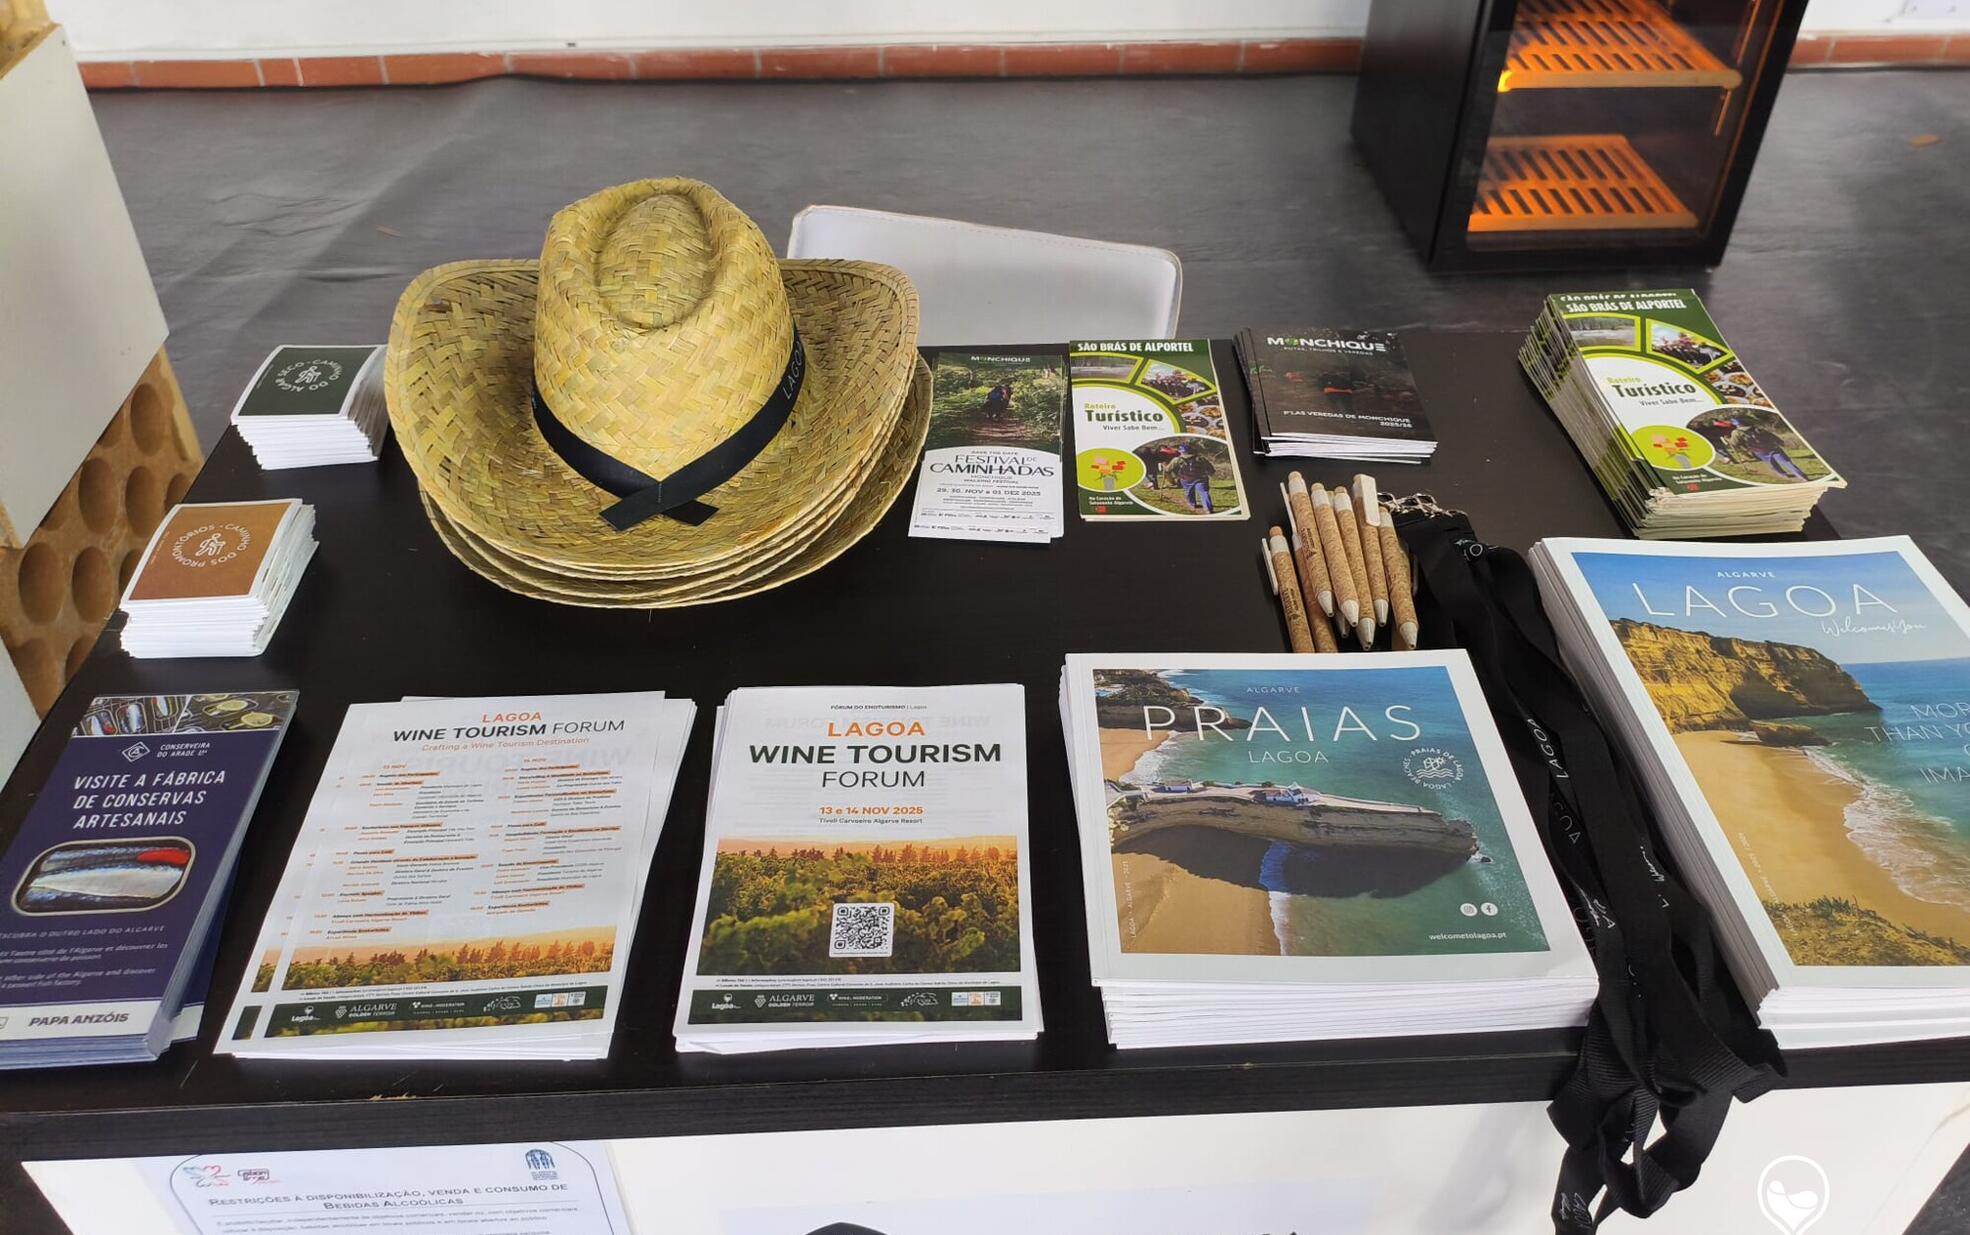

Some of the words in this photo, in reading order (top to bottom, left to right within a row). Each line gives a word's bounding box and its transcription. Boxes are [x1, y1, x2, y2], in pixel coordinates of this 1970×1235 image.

[1590, 302, 1618, 312] BRÁS
[1620, 301, 1634, 311] DE
[1636, 299, 1687, 310] ALPORTEL
[1100, 342, 1126, 351] BRÁS
[1130, 343, 1142, 351] DE
[1145, 342, 1194, 352] ALPORTEL
[1267, 336, 1386, 352] MONCHIQUE
[1611, 382, 1697, 398] Turístico
[1085, 410, 1164, 423] Turístico
[1307, 411, 1344, 419] VEREDAS
[1358, 415, 1411, 423] MONCHIQUE
[955, 455, 1026, 465] FESTIVAL
[930, 463, 1054, 477] CAMINHADAS
[210, 552, 237, 566] DOS
[1632, 583, 1898, 619] LAGOA
[1246, 686, 1300, 694] ALGARVE
[483, 712, 543, 724] LAGOA
[1142, 705, 1421, 743] PRAIAS
[393, 729, 448, 742] WINE
[453, 724, 547, 739] TOURISM
[551, 720, 626, 734] FORUM
[828, 722, 926, 737] LAGOA
[1864, 725, 1944, 742] THAN
[160, 742, 211, 751] CONSERVEIRA
[422, 743, 460, 752] Crafting
[471, 741, 494, 750] Wine
[497, 740, 535, 749] Tourism
[537, 737, 590, 747] Destination
[157, 750, 168, 759] DO
[171, 749, 195, 758] ARADE
[749, 745, 836, 764] WINE
[847, 744, 1001, 764] TOURISM
[1248, 751, 1329, 764] LAGOA
[74, 774, 131, 790] VISITE
[134, 773, 146, 787] A
[153, 770, 227, 787] FÁBRICA
[822, 770, 926, 788] FORUM
[73, 795, 94, 810] DE
[102, 790, 208, 808] CONSERVAS
[820, 807, 833, 815] 13
[846, 807, 859, 815] 14
[862, 807, 890, 815] NOV
[893, 806, 924, 815] 2025
[72, 811, 188, 829] ARTESANAIS
[1429, 932, 1507, 941] welcometolagoa.pt
[769, 994, 815, 1002] ALGARVE
[350, 1003, 398, 1013] ALGARVE
[28, 1014, 71, 1027] PAPA
[71, 1010, 129, 1025] ANZÓIS
[485, 1185, 549, 1194] CONSUMO
[324, 1200, 379, 1210] BEBIDAS
